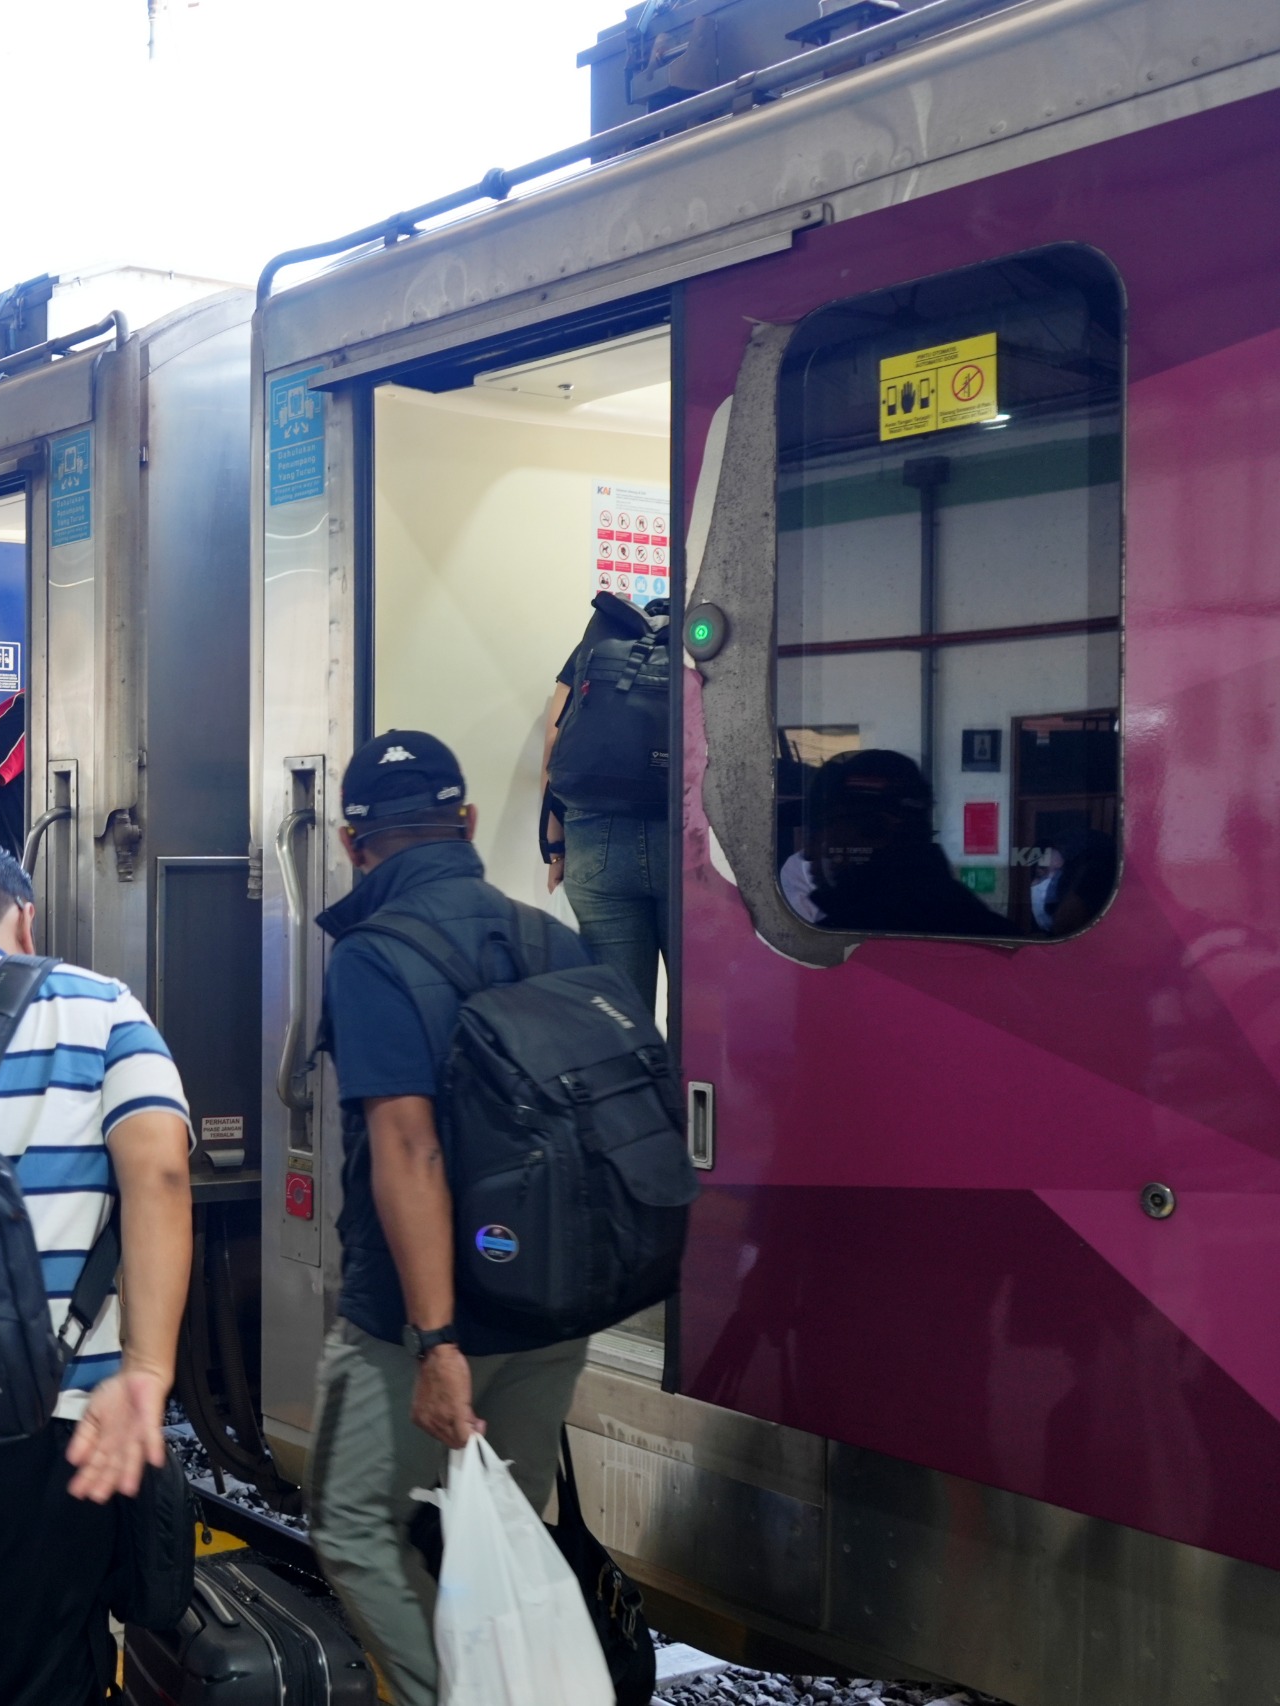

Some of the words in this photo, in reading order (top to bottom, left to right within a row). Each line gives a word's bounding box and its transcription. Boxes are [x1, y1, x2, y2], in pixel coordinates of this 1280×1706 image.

[278, 444, 316, 460] Dahulukan
[278, 455, 316, 470] Penumpang
[279, 472, 295, 481] Yang
[296, 467, 316, 476] Turun
[1011, 847, 1052, 867] KAI
[205, 1118, 240, 1126] PERHATIAN
